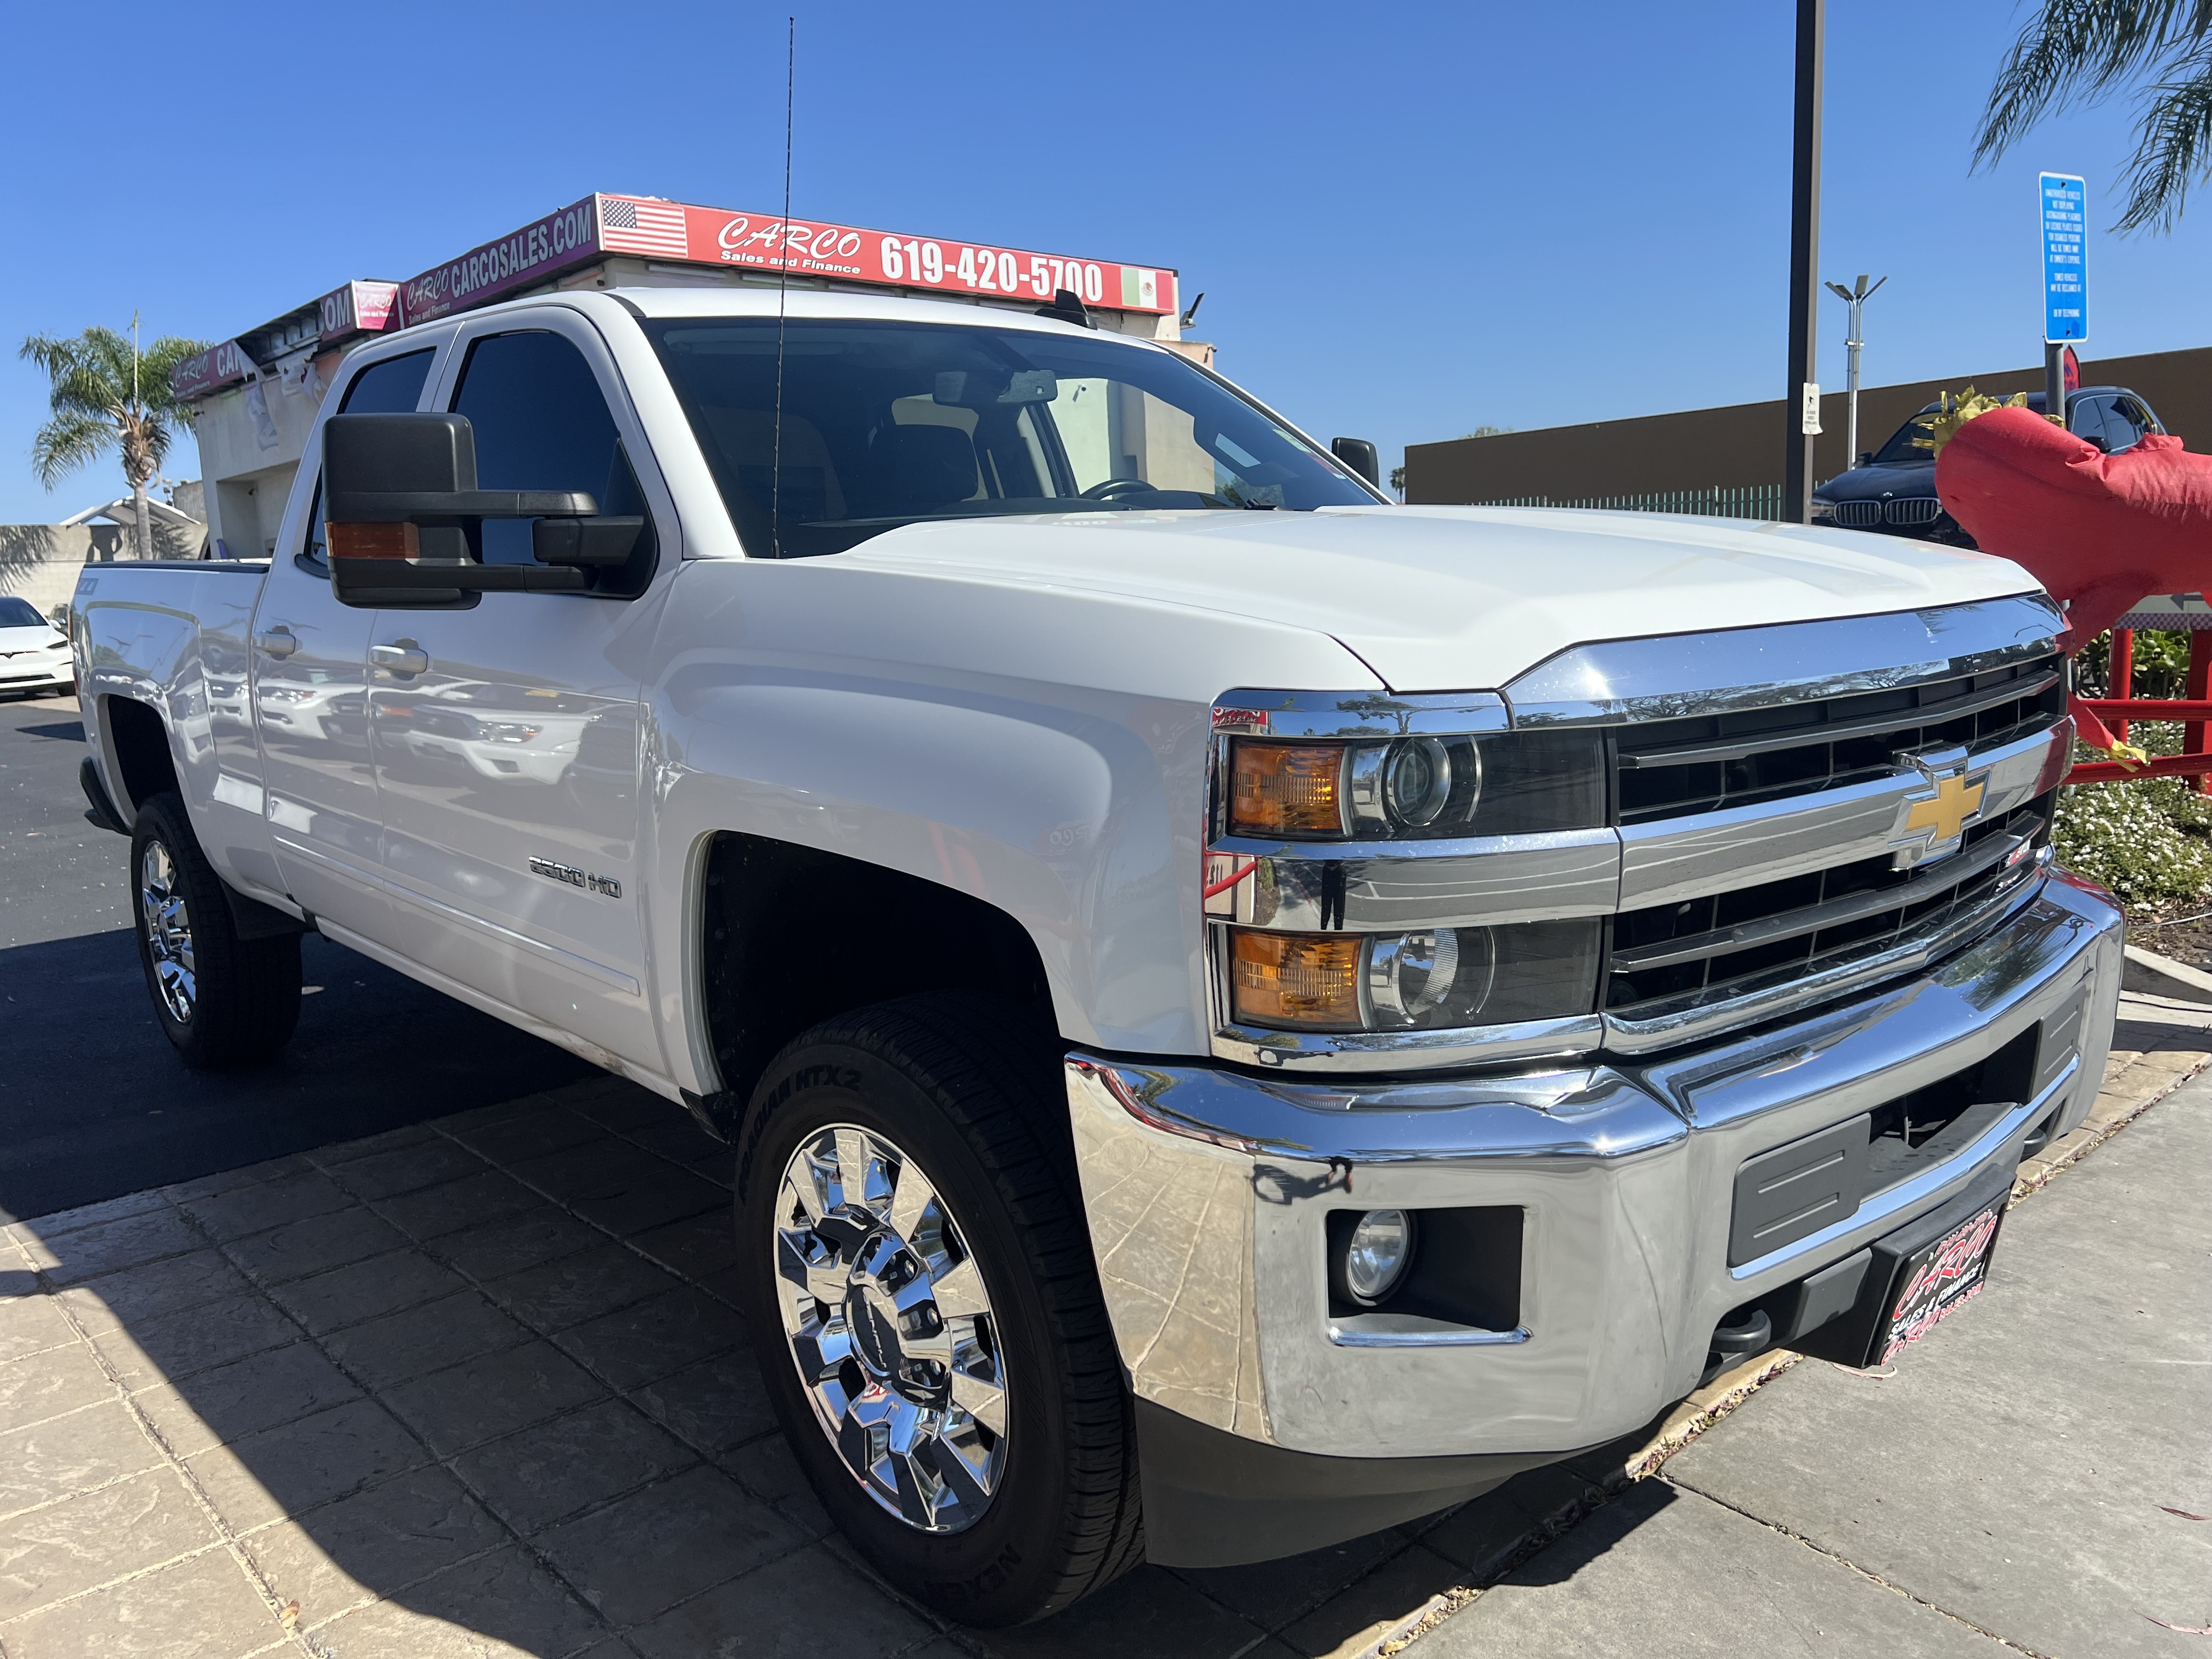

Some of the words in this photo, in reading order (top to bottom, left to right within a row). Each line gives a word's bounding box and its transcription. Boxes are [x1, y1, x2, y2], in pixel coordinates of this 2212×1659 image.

[451, 204, 591, 298] CARCOSALES.COM
[717, 217, 861, 259] CARCO
[720, 250, 764, 264] Sales
[769, 255, 798, 268] and
[802, 257, 861, 275] Finance
[881, 236, 1103, 302] 619-420-5700
[320, 289, 351, 332] OM
[359, 292, 392, 309] CARCO
[407, 268, 449, 311] CARCO
[175, 354, 208, 388] CARCO
[528, 855, 585, 888] 2500
[588, 872, 622, 899] HD
[1892, 1215, 1997, 1322] CARCO
[1888, 1303, 1927, 1340] SALES
[1925, 1296, 1936, 1313] &
[1935, 1262, 1981, 1306] FINANCE
